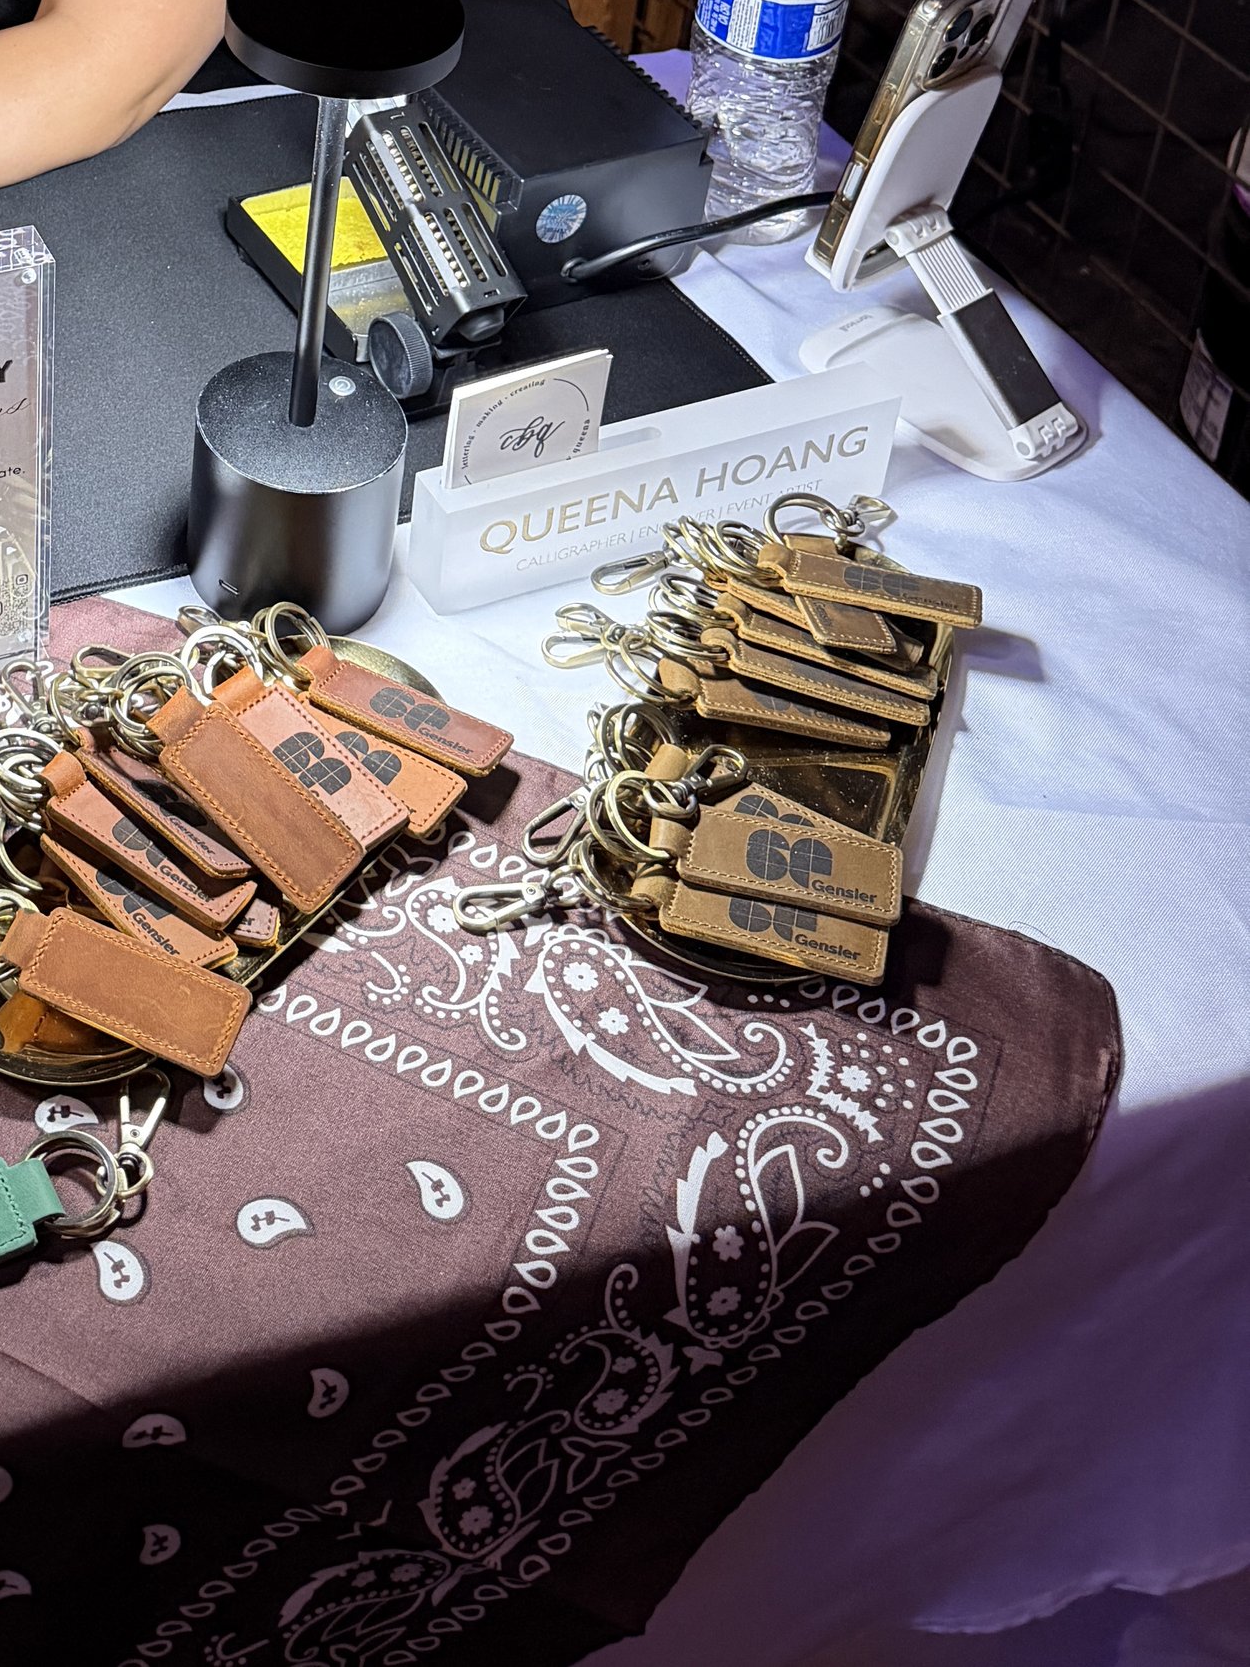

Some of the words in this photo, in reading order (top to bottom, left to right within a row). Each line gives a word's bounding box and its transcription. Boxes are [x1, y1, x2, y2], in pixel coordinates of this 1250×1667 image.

[476, 399, 503, 428] making
[509, 379, 546, 397] creating
[572, 418, 591, 454] queena
[479, 477, 679, 555] QUEENA
[695, 424, 869, 498] HOANG
[516, 532, 626, 572] CALLIGRAPHER
[726, 492, 774, 515] EVENT
[418, 727, 474, 756] Gensler
[169, 815, 216, 855] Gensler
[812, 879, 877, 904] Gensler
[132, 912, 181, 956] Gensler
[795, 933, 861, 961] Gensler
